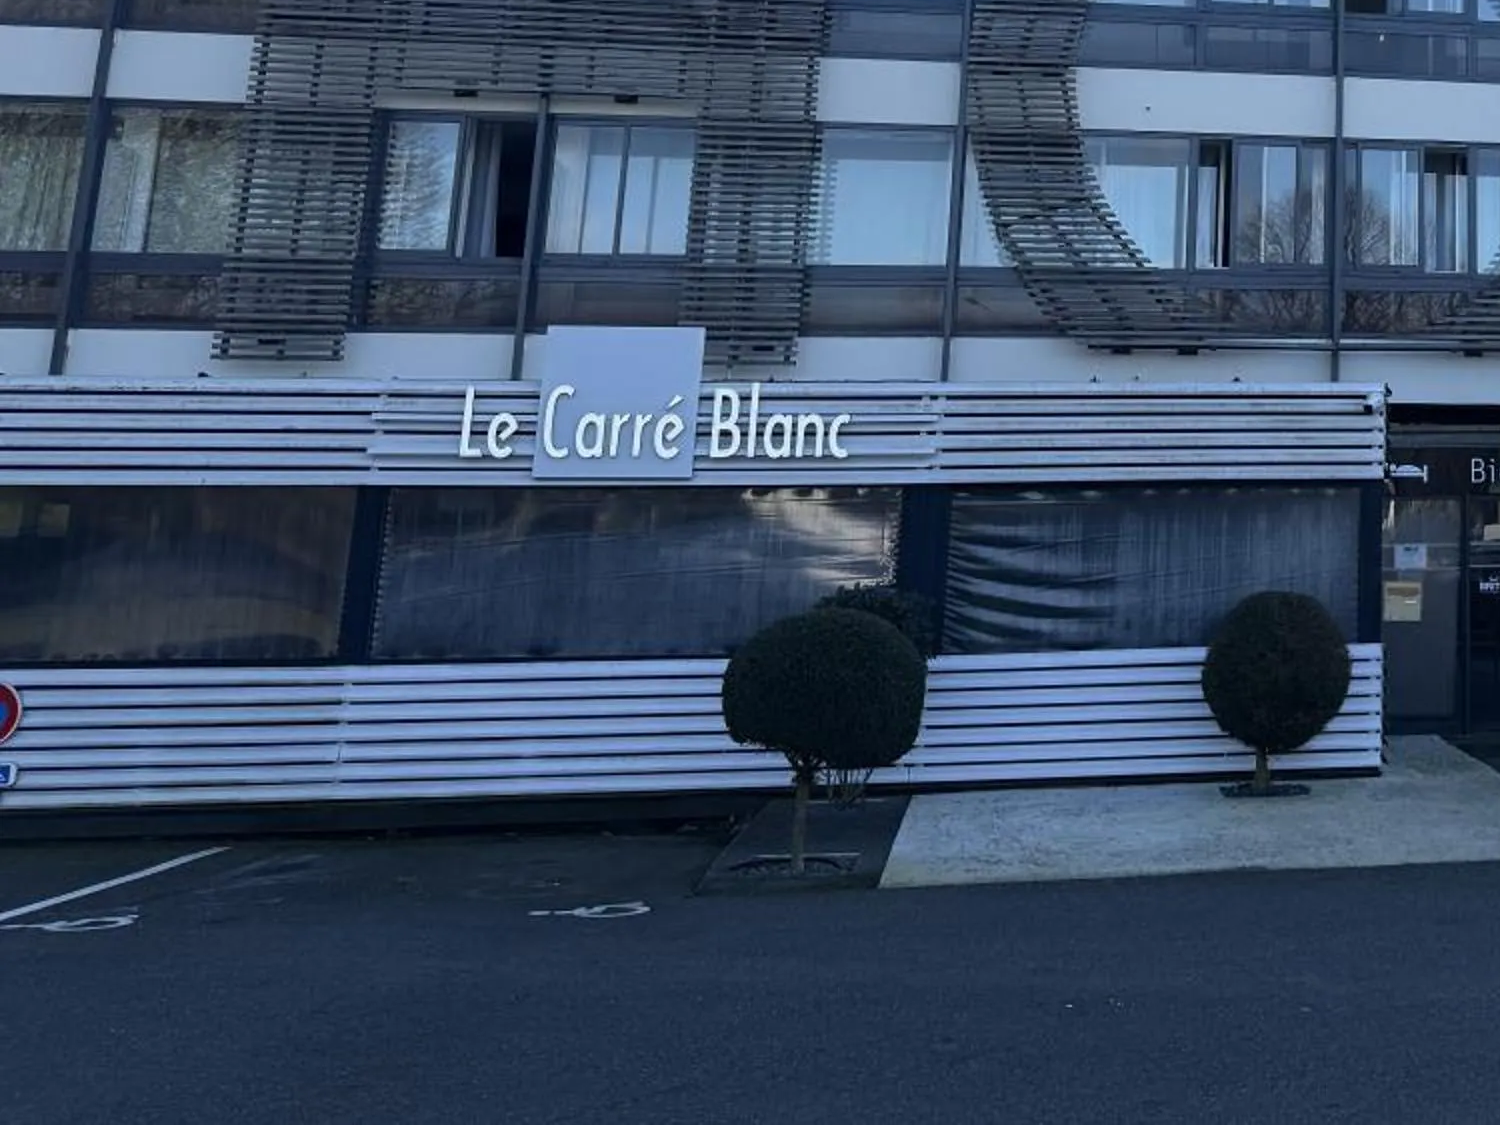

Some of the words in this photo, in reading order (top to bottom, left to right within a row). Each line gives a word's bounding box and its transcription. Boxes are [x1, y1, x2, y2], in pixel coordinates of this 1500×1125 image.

[459, 385, 519, 460] Le
[543, 384, 685, 460] Carré
[709, 382, 851, 459] Blanc
